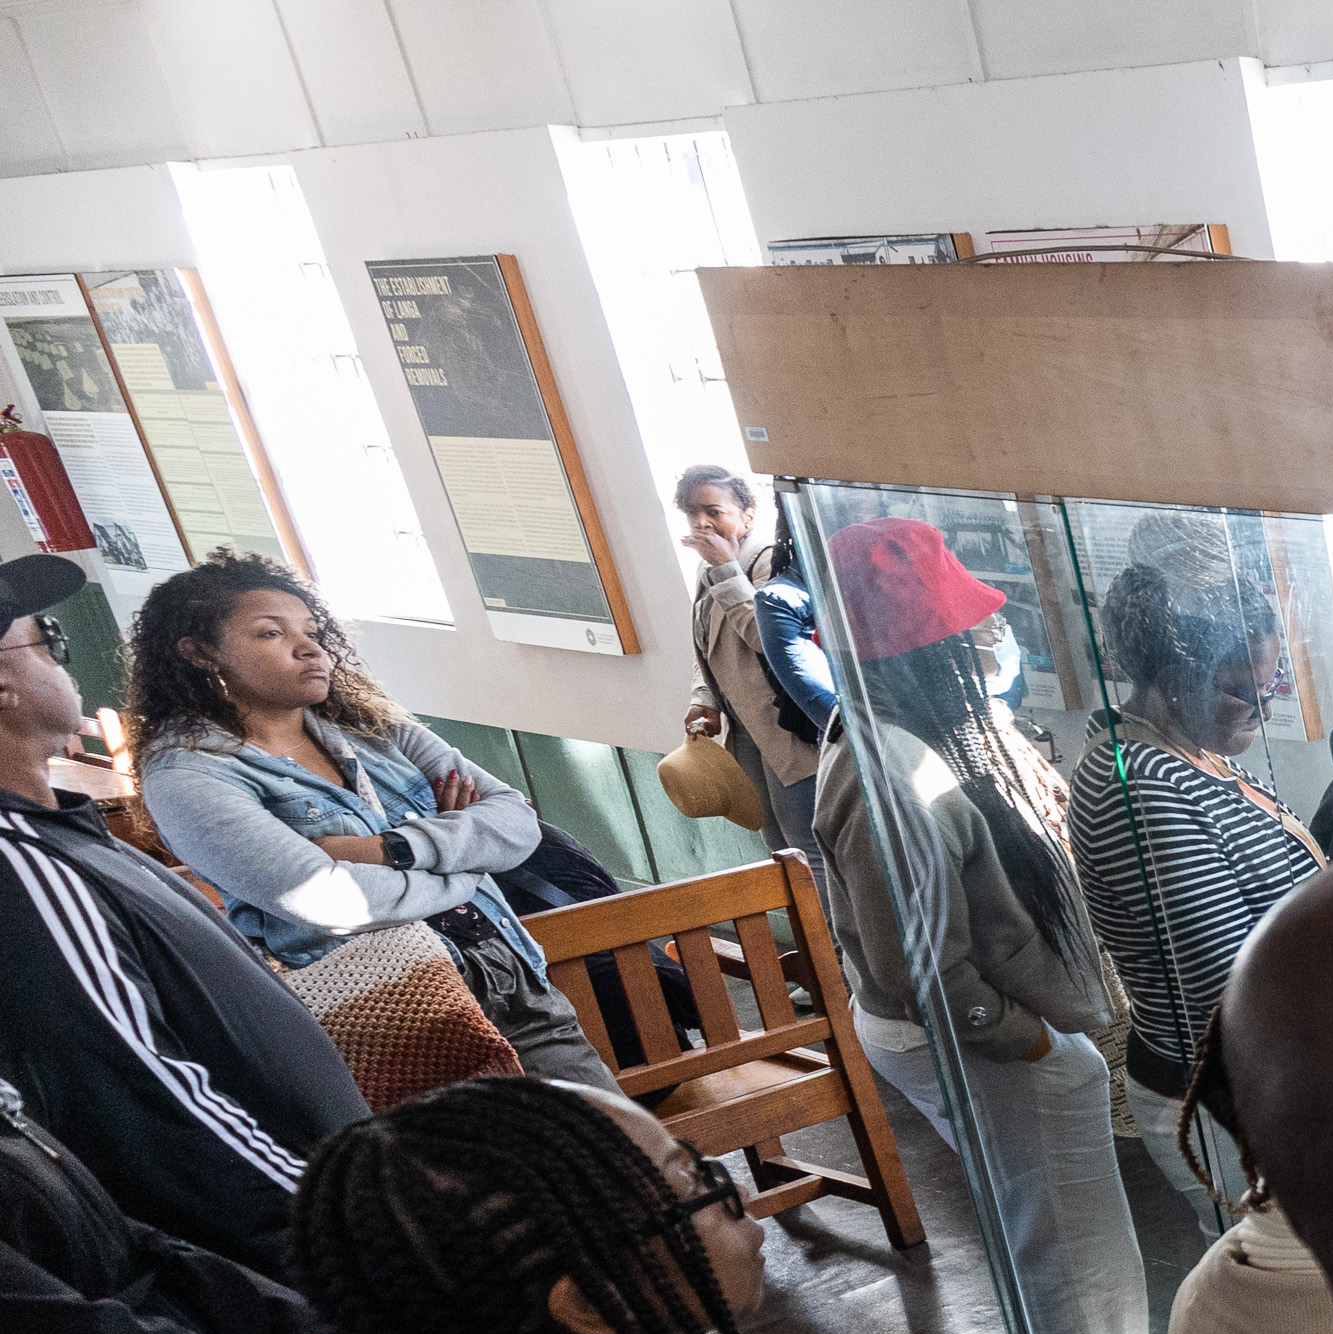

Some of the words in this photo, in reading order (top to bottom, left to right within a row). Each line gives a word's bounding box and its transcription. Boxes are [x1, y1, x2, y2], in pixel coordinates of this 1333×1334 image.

[374, 278, 392, 296] THE
[390, 276, 452, 296] ESTABLISHMENT
[382, 302, 396, 318] OF
[394, 300, 422, 318] LANGA
[390, 324, 409, 342] AND
[398, 346, 430, 364] FORCED
[405, 368, 448, 386] REMOVALS
